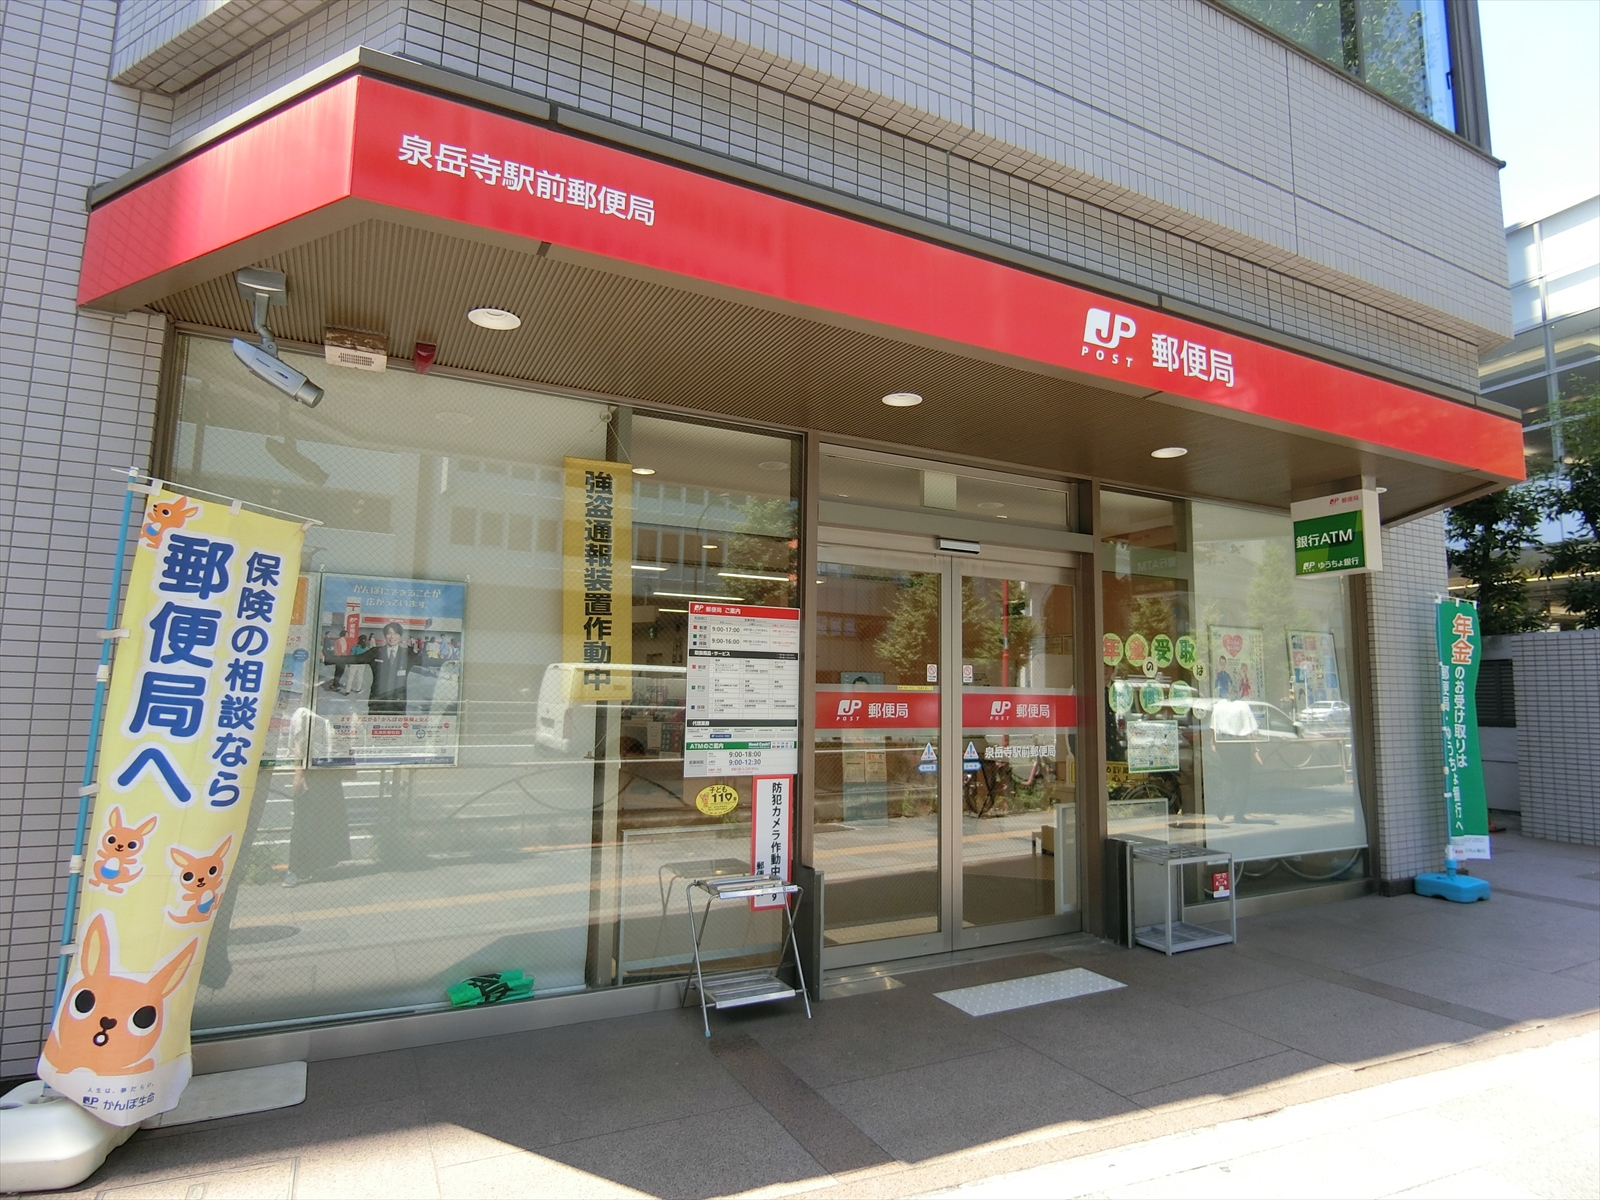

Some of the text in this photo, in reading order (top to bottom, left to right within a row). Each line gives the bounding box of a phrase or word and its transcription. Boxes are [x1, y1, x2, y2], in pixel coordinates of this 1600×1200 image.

[398, 134, 656, 227] 泉岳寺駅前郵便局
[1083, 307, 1137, 349] JP
[1081, 346, 1134, 368] POST
[1151, 333, 1235, 388] 郵便局
[1295, 528, 1353, 549] 銀行ATM
[1317, 556, 1360, 570] ゆうちょ銀行
[353, 584, 442, 598] かんぽにできることが
[583, 470, 614, 691] 強盗通報装置作動中
[724, 607, 741, 615] ご案内
[117, 533, 235, 803] 郵便局へ
[208, 551, 282, 807] 保険の相談なら
[1451, 613, 1474, 768] 年金のお受け取りは
[837, 699, 909, 719] JP 郵便局
[990, 700, 1051, 719] JP 郵便局
[984, 745, 1057, 759] 泉岳寺駅前郵便局
[771, 782, 782, 900] 防犯カメラ作動中
[87, 1082, 155, 1094] 人生は、夢だらけ。
[102, 1092, 156, 1111] かんぽ生命
